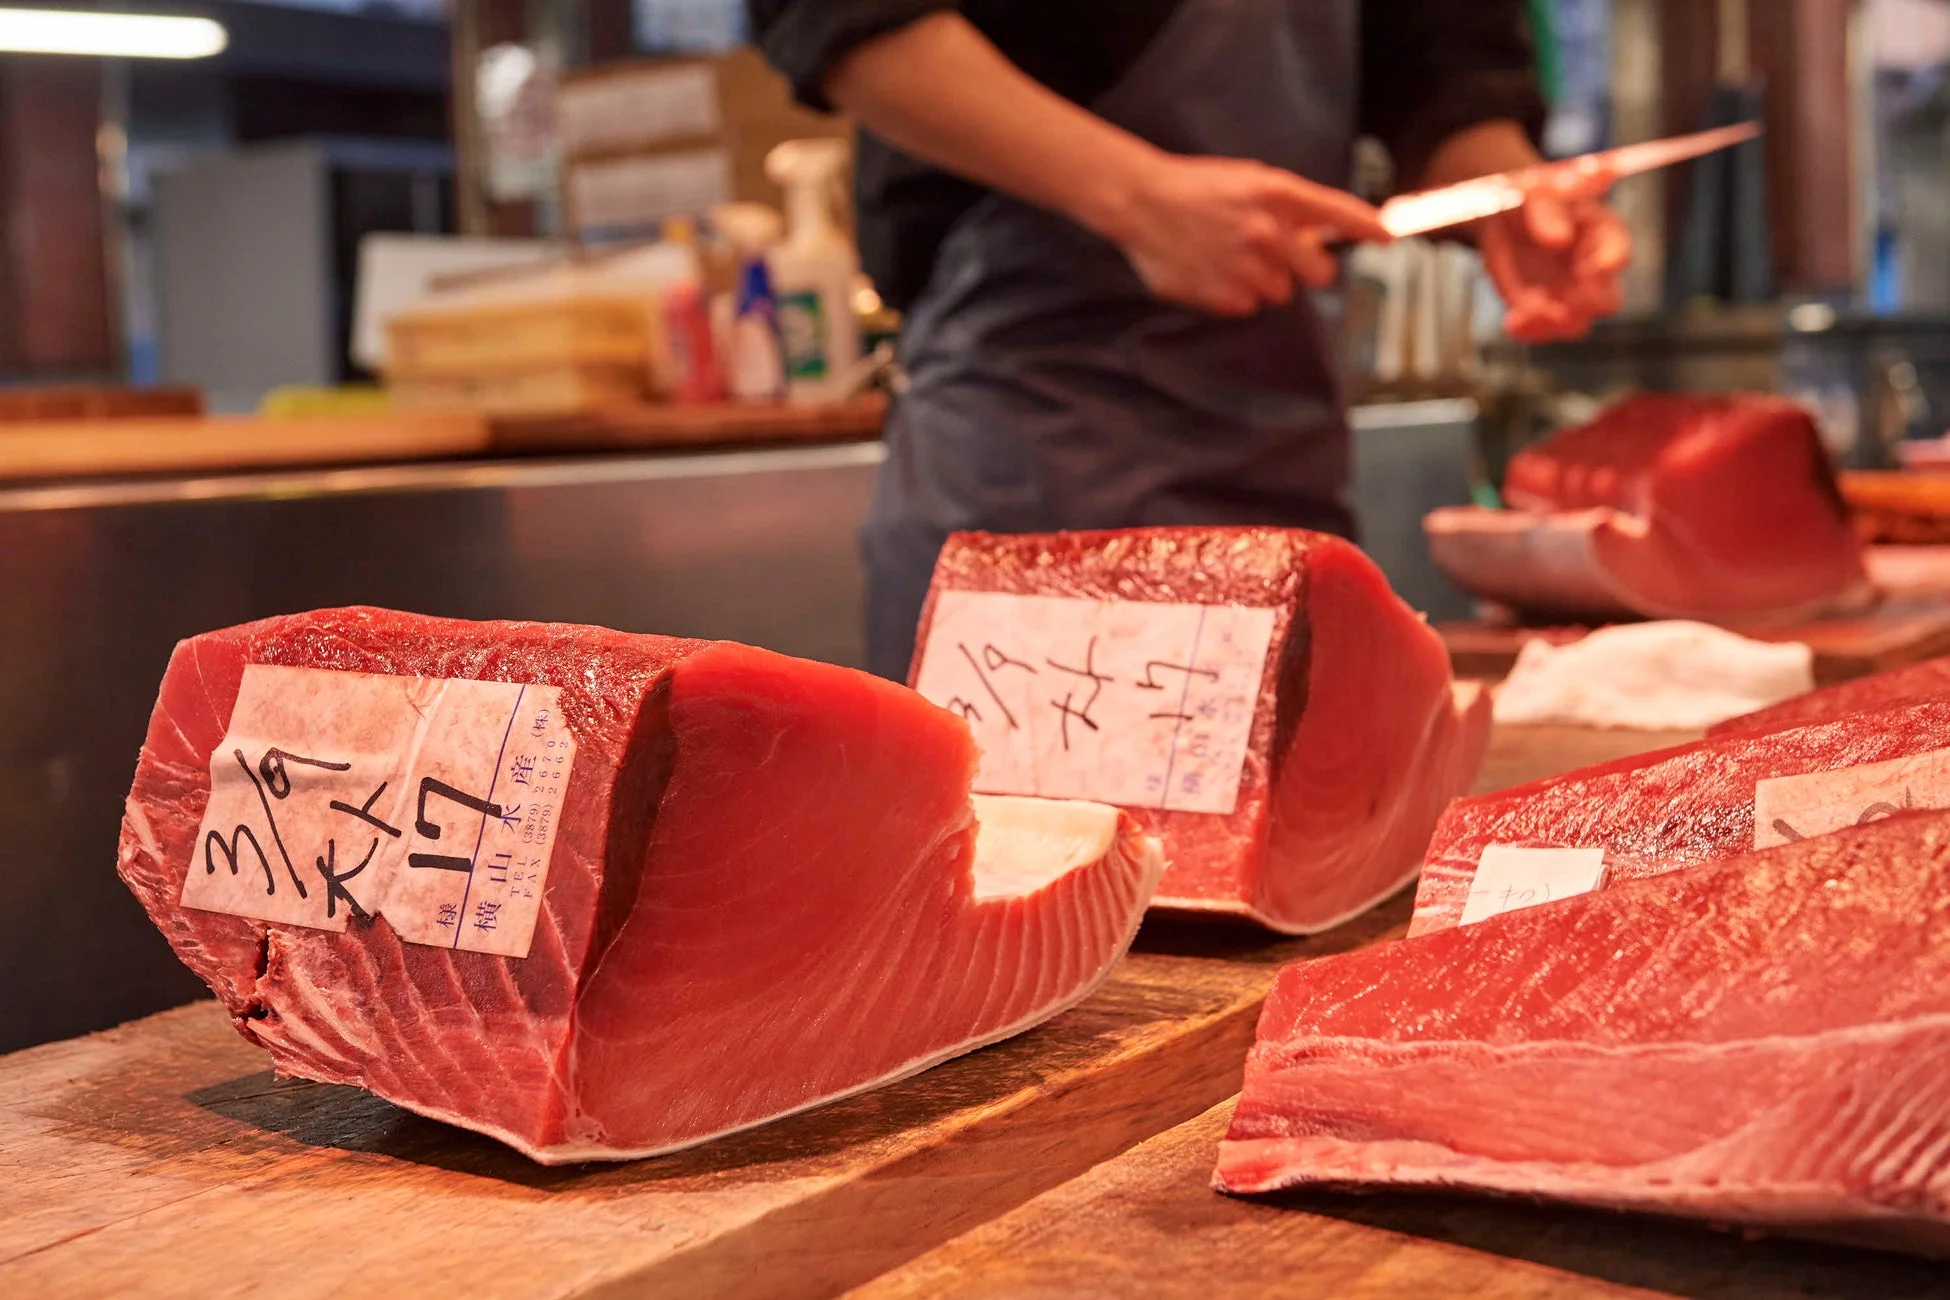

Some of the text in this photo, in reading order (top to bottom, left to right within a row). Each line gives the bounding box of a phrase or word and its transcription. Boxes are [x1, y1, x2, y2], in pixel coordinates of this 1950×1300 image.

[205, 746, 351, 898] 3/9
[408, 776, 502, 873] 17
[510, 740, 556, 897] TEL (3879) 2670
[523, 741, 569, 900] FAX (3879) 2662
[436, 903, 458, 928] 様
